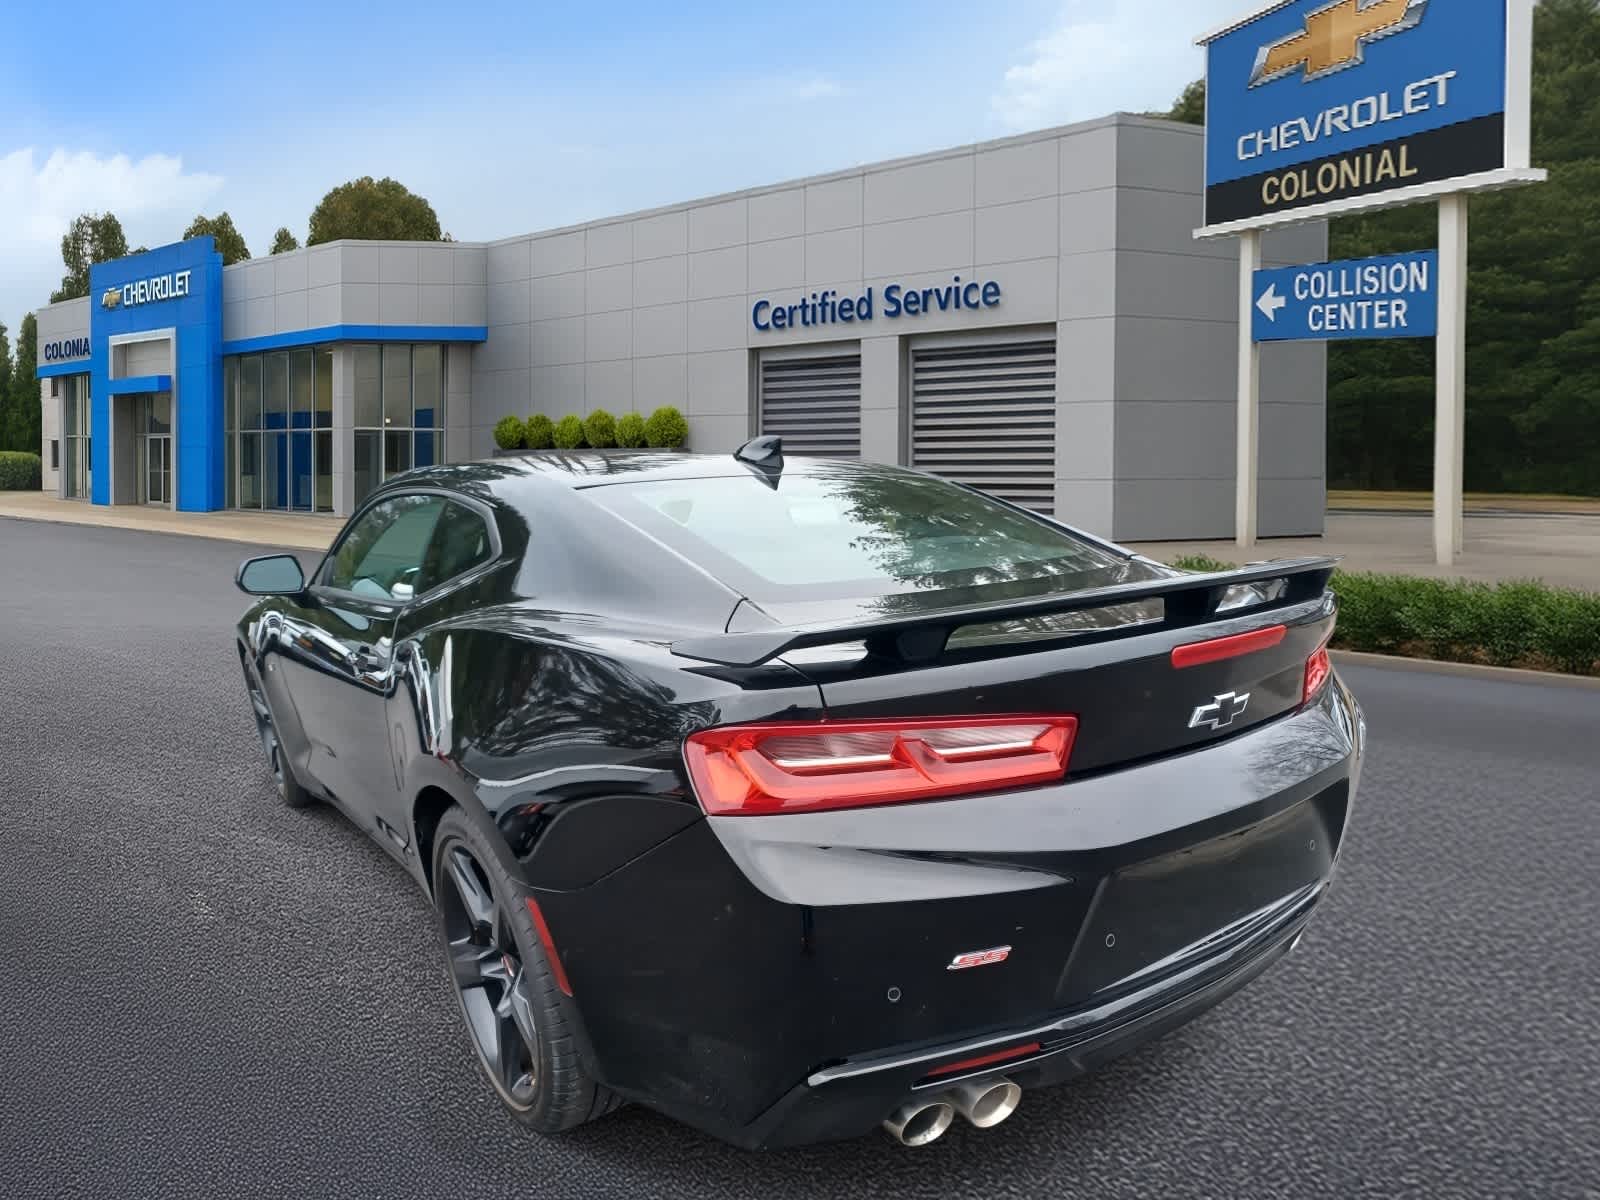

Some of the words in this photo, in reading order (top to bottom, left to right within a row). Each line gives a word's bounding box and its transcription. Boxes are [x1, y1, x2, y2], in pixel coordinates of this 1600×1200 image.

[1237, 70, 1456, 160] CHEVROLET
[1262, 145, 1418, 204] COLONIAL
[123, 270, 191, 306] CHEVROLET
[753, 287, 873, 331] Certified
[883, 276, 1001, 318] Service
[1294, 260, 1428, 300] COLLISION
[1307, 300, 1408, 331] CENTER
